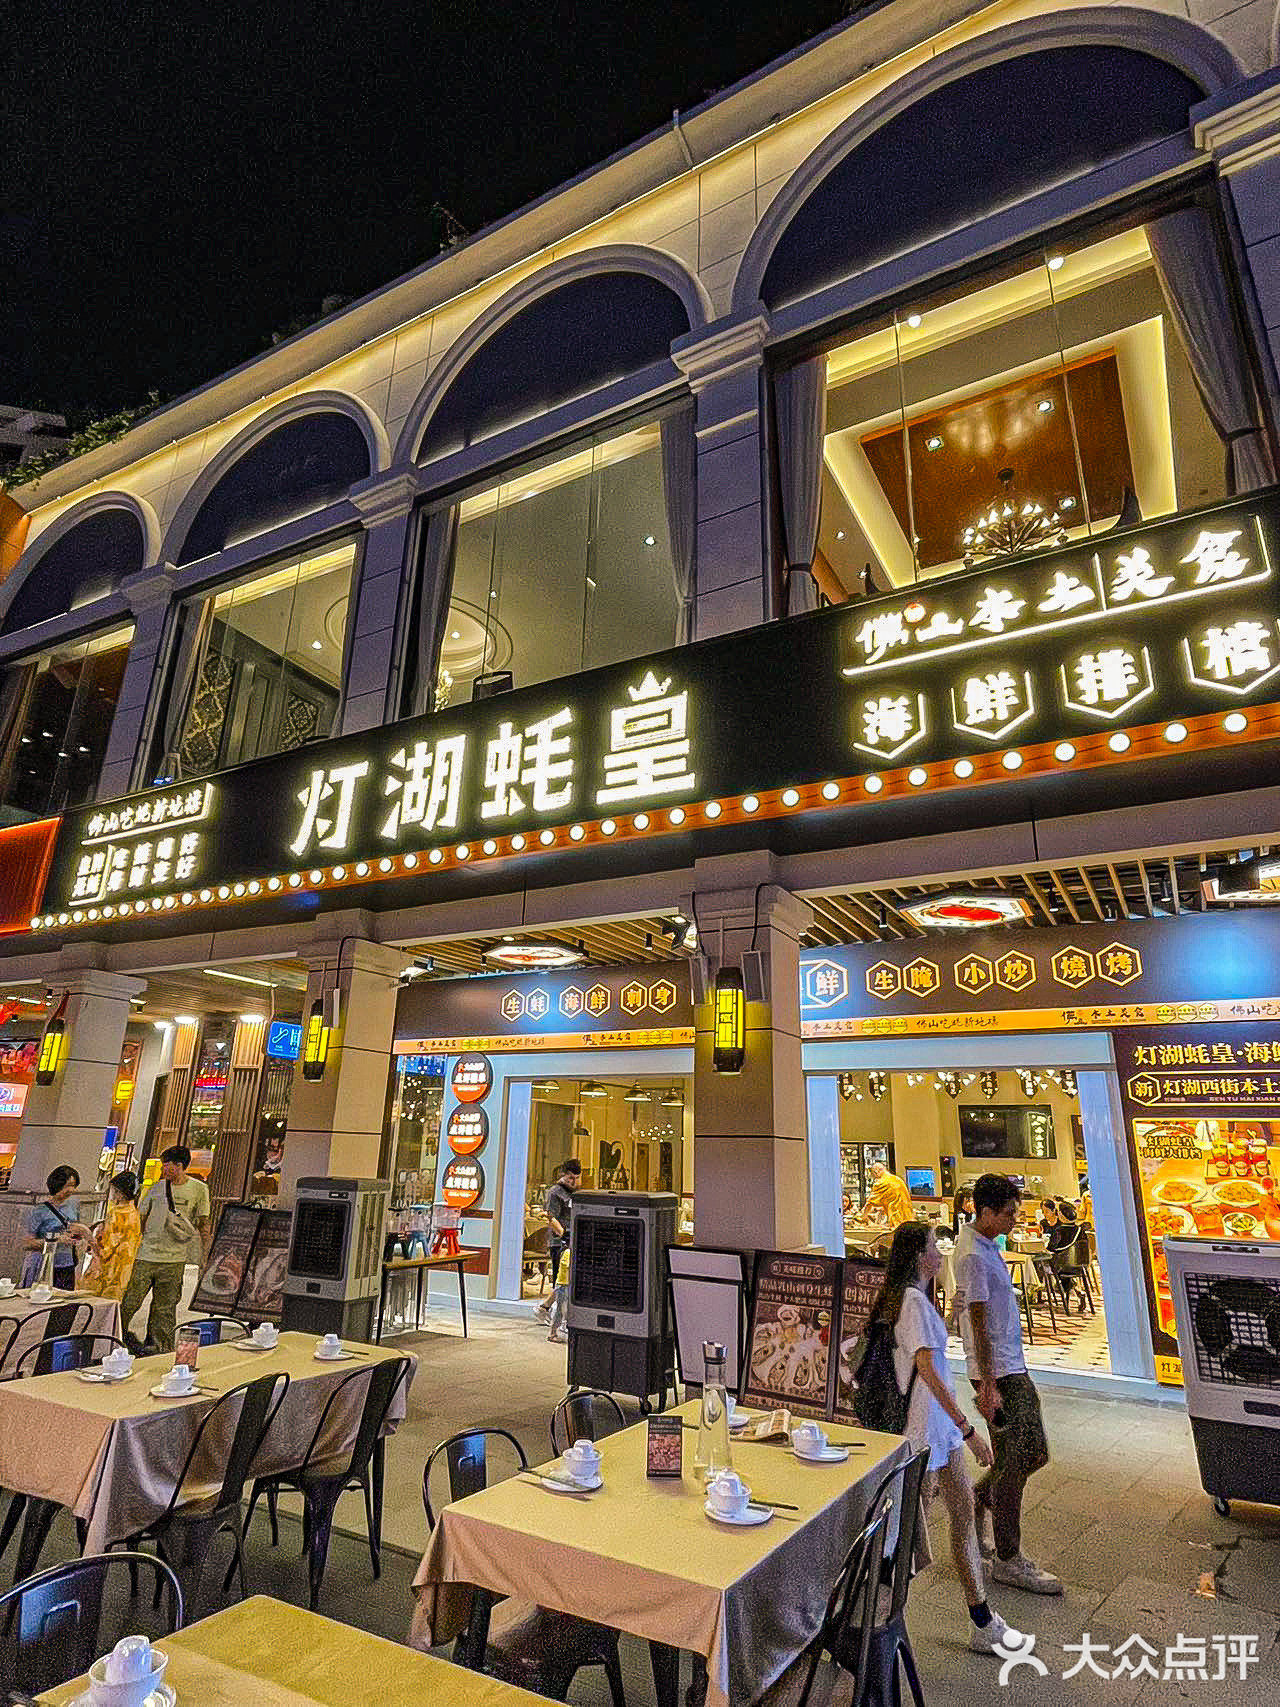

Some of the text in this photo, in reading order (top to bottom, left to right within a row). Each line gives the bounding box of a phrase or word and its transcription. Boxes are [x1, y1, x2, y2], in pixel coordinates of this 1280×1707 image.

[289, 671, 696, 857] 灯湖蚝皇
[962, 958, 1029, 987] 小炒
[1134, 1080, 1154, 1098] 新
[1162, 1077, 1280, 1096] 灯湖西街本土
